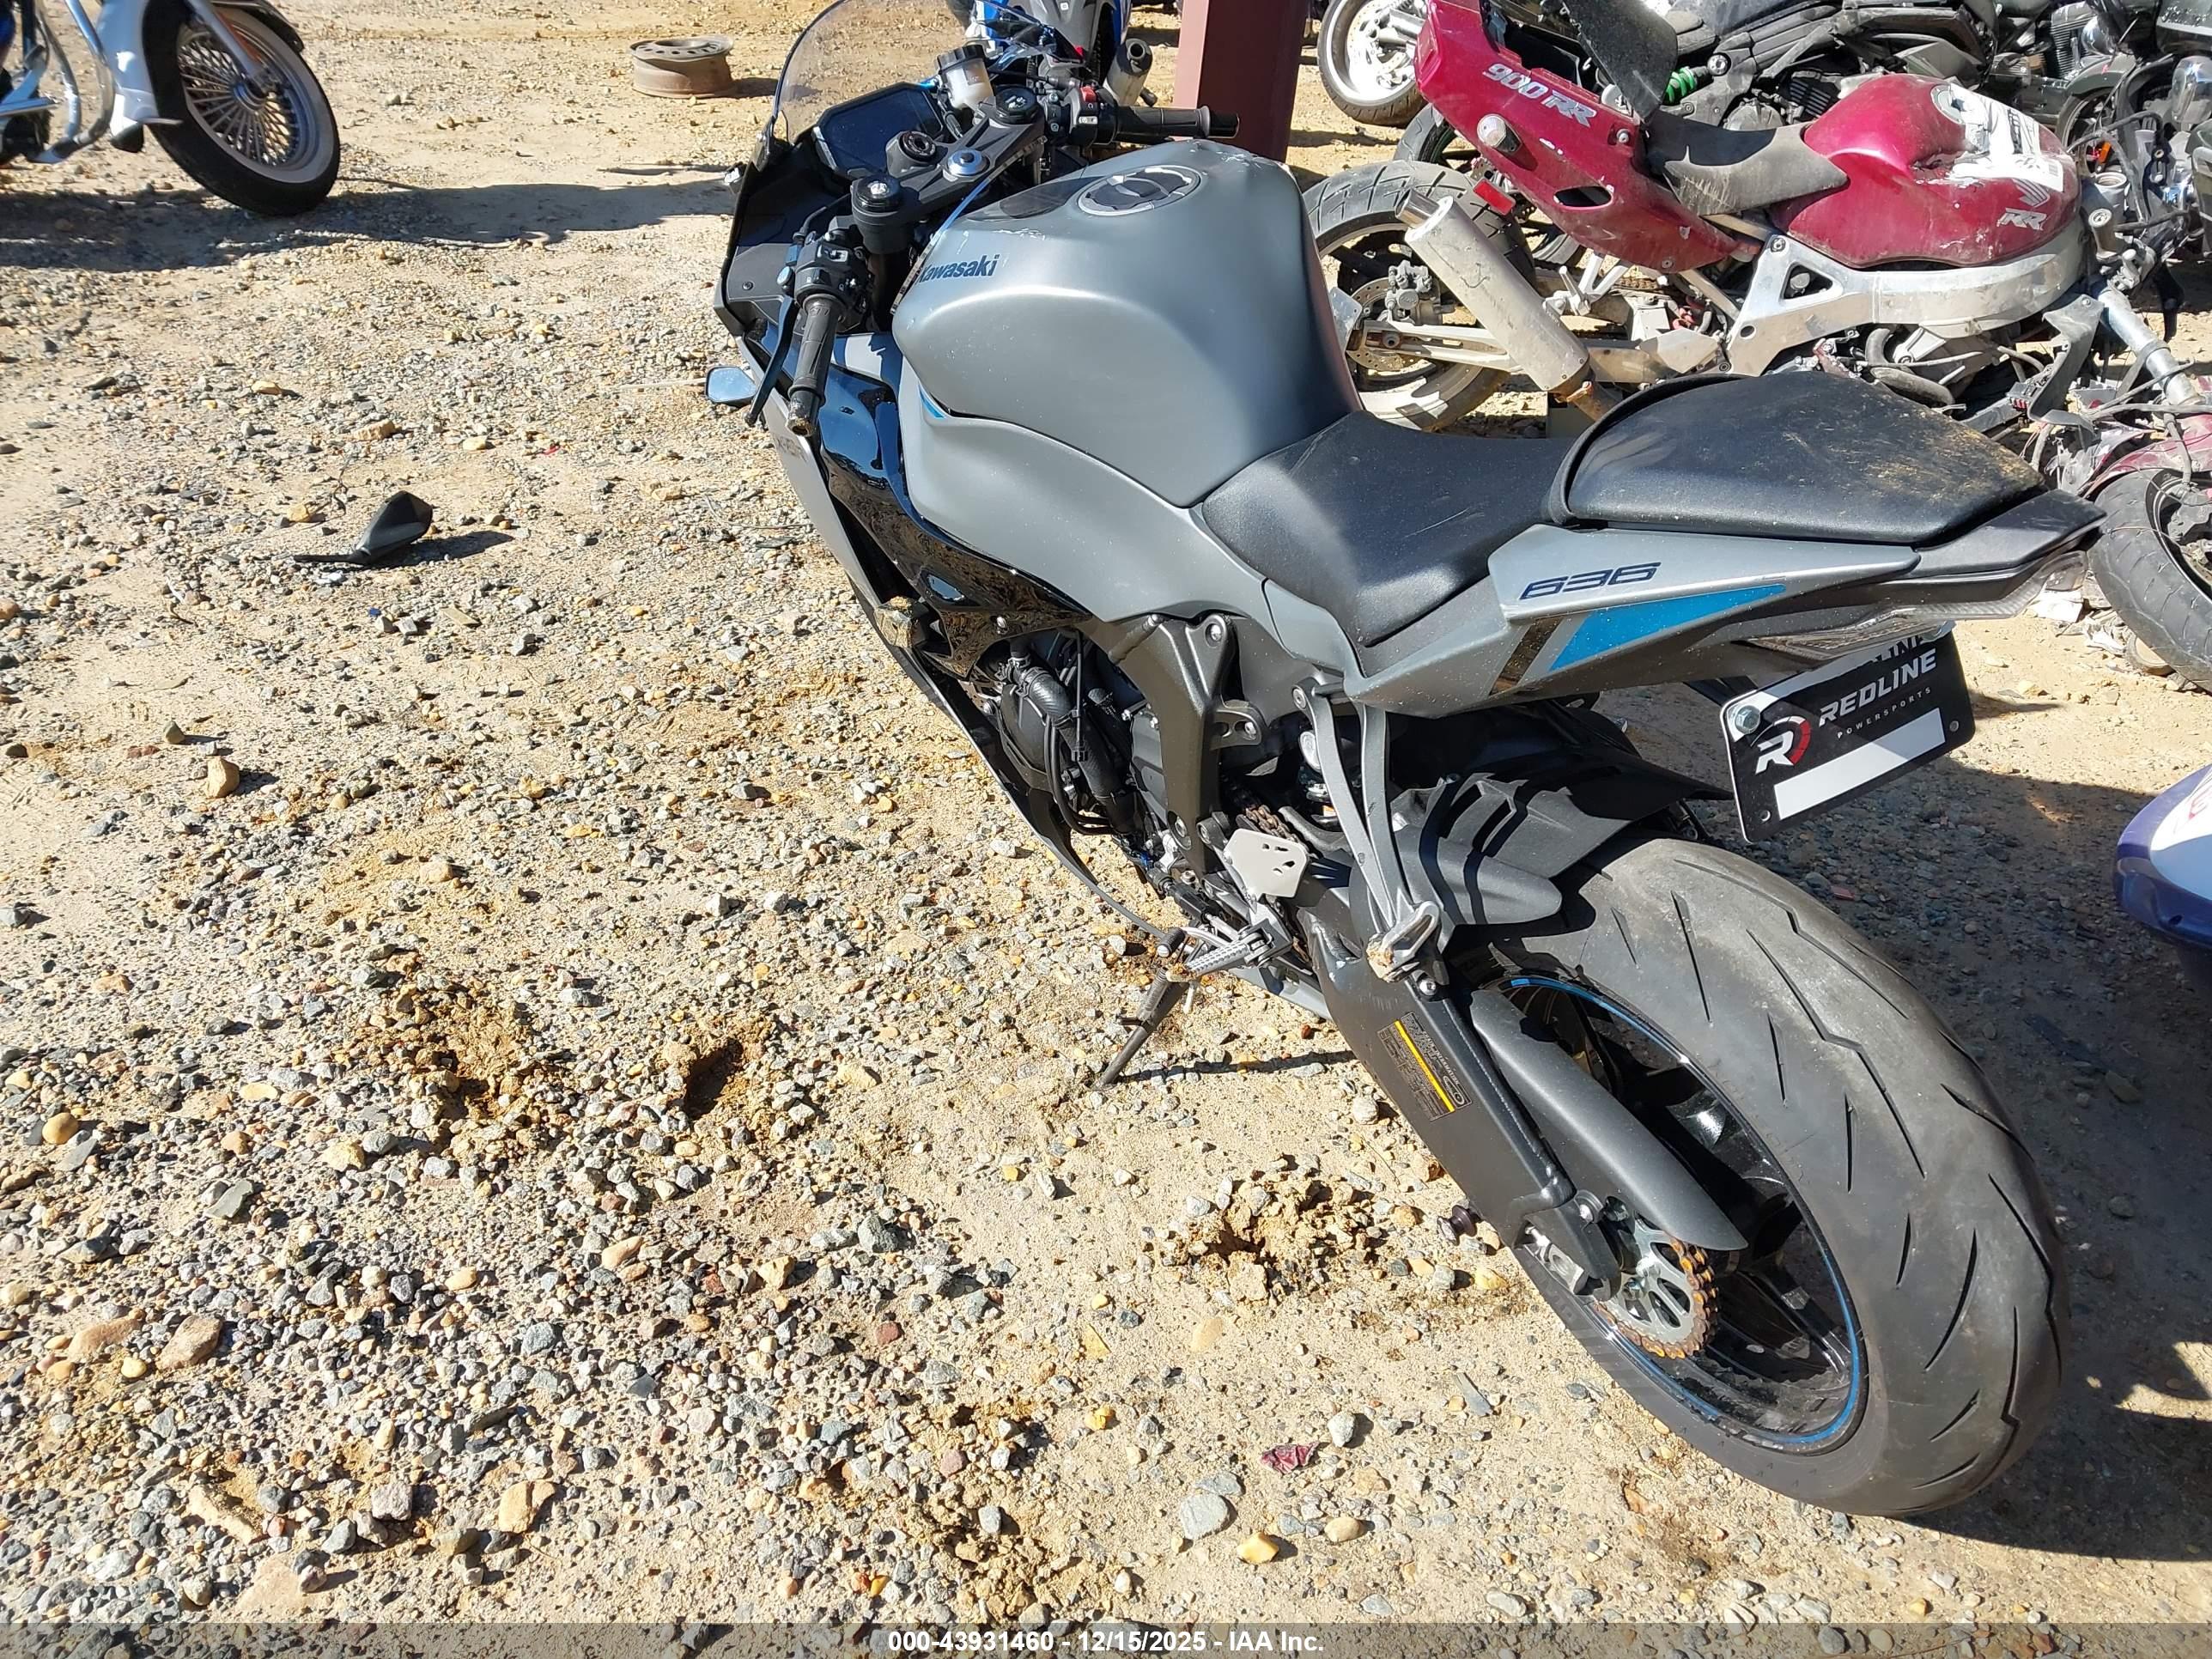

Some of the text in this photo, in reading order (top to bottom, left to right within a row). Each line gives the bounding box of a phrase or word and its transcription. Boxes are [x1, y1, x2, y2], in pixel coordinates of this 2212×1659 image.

[1482, 64, 1597, 128] 900 RR
[1996, 207, 2047, 231] RR
[917, 254, 1000, 283] Kawasaki
[1518, 562, 1662, 600] 636
[1819, 648, 1936, 727] REDLINE
[1837, 687, 1931, 738] POWERSPORTS
